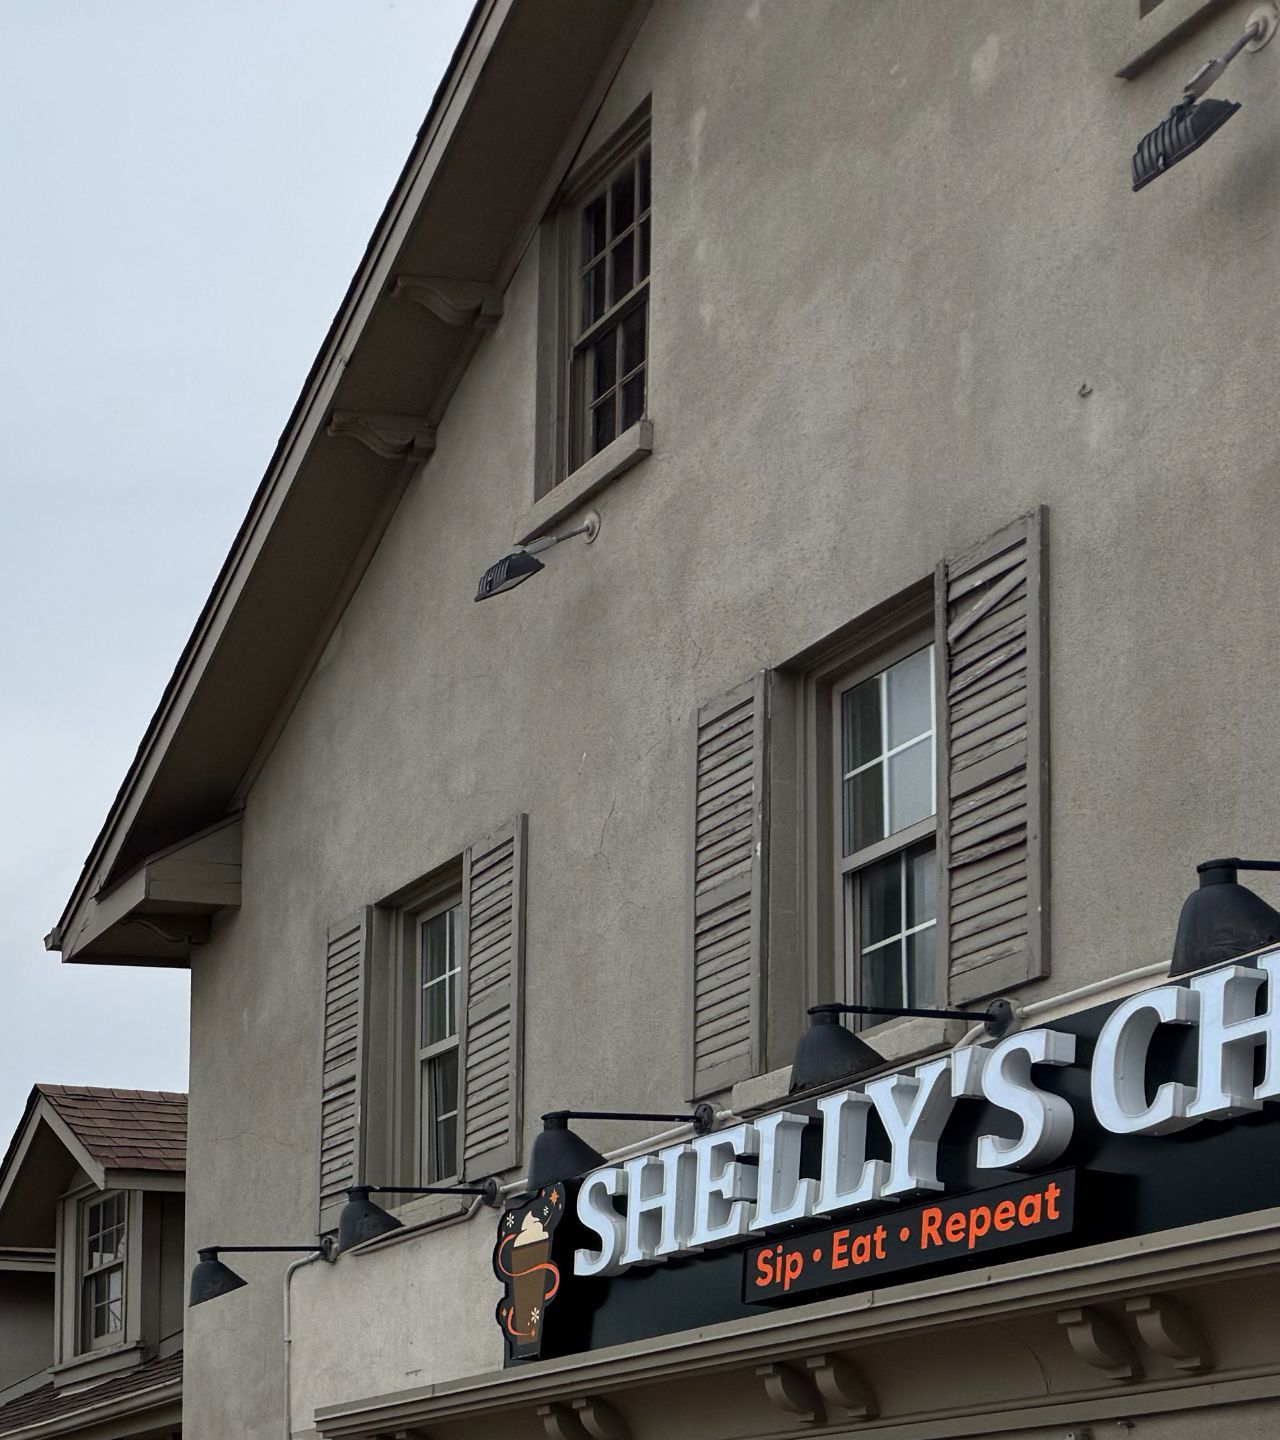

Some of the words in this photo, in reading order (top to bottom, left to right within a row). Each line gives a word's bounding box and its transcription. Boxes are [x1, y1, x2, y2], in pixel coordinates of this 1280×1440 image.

[574, 1028, 1075, 1277] SHELLY'S
[755, 1246, 803, 1290] Sip
[831, 1226, 887, 1271] Eat
[920, 1181, 1061, 1250] Repeat
